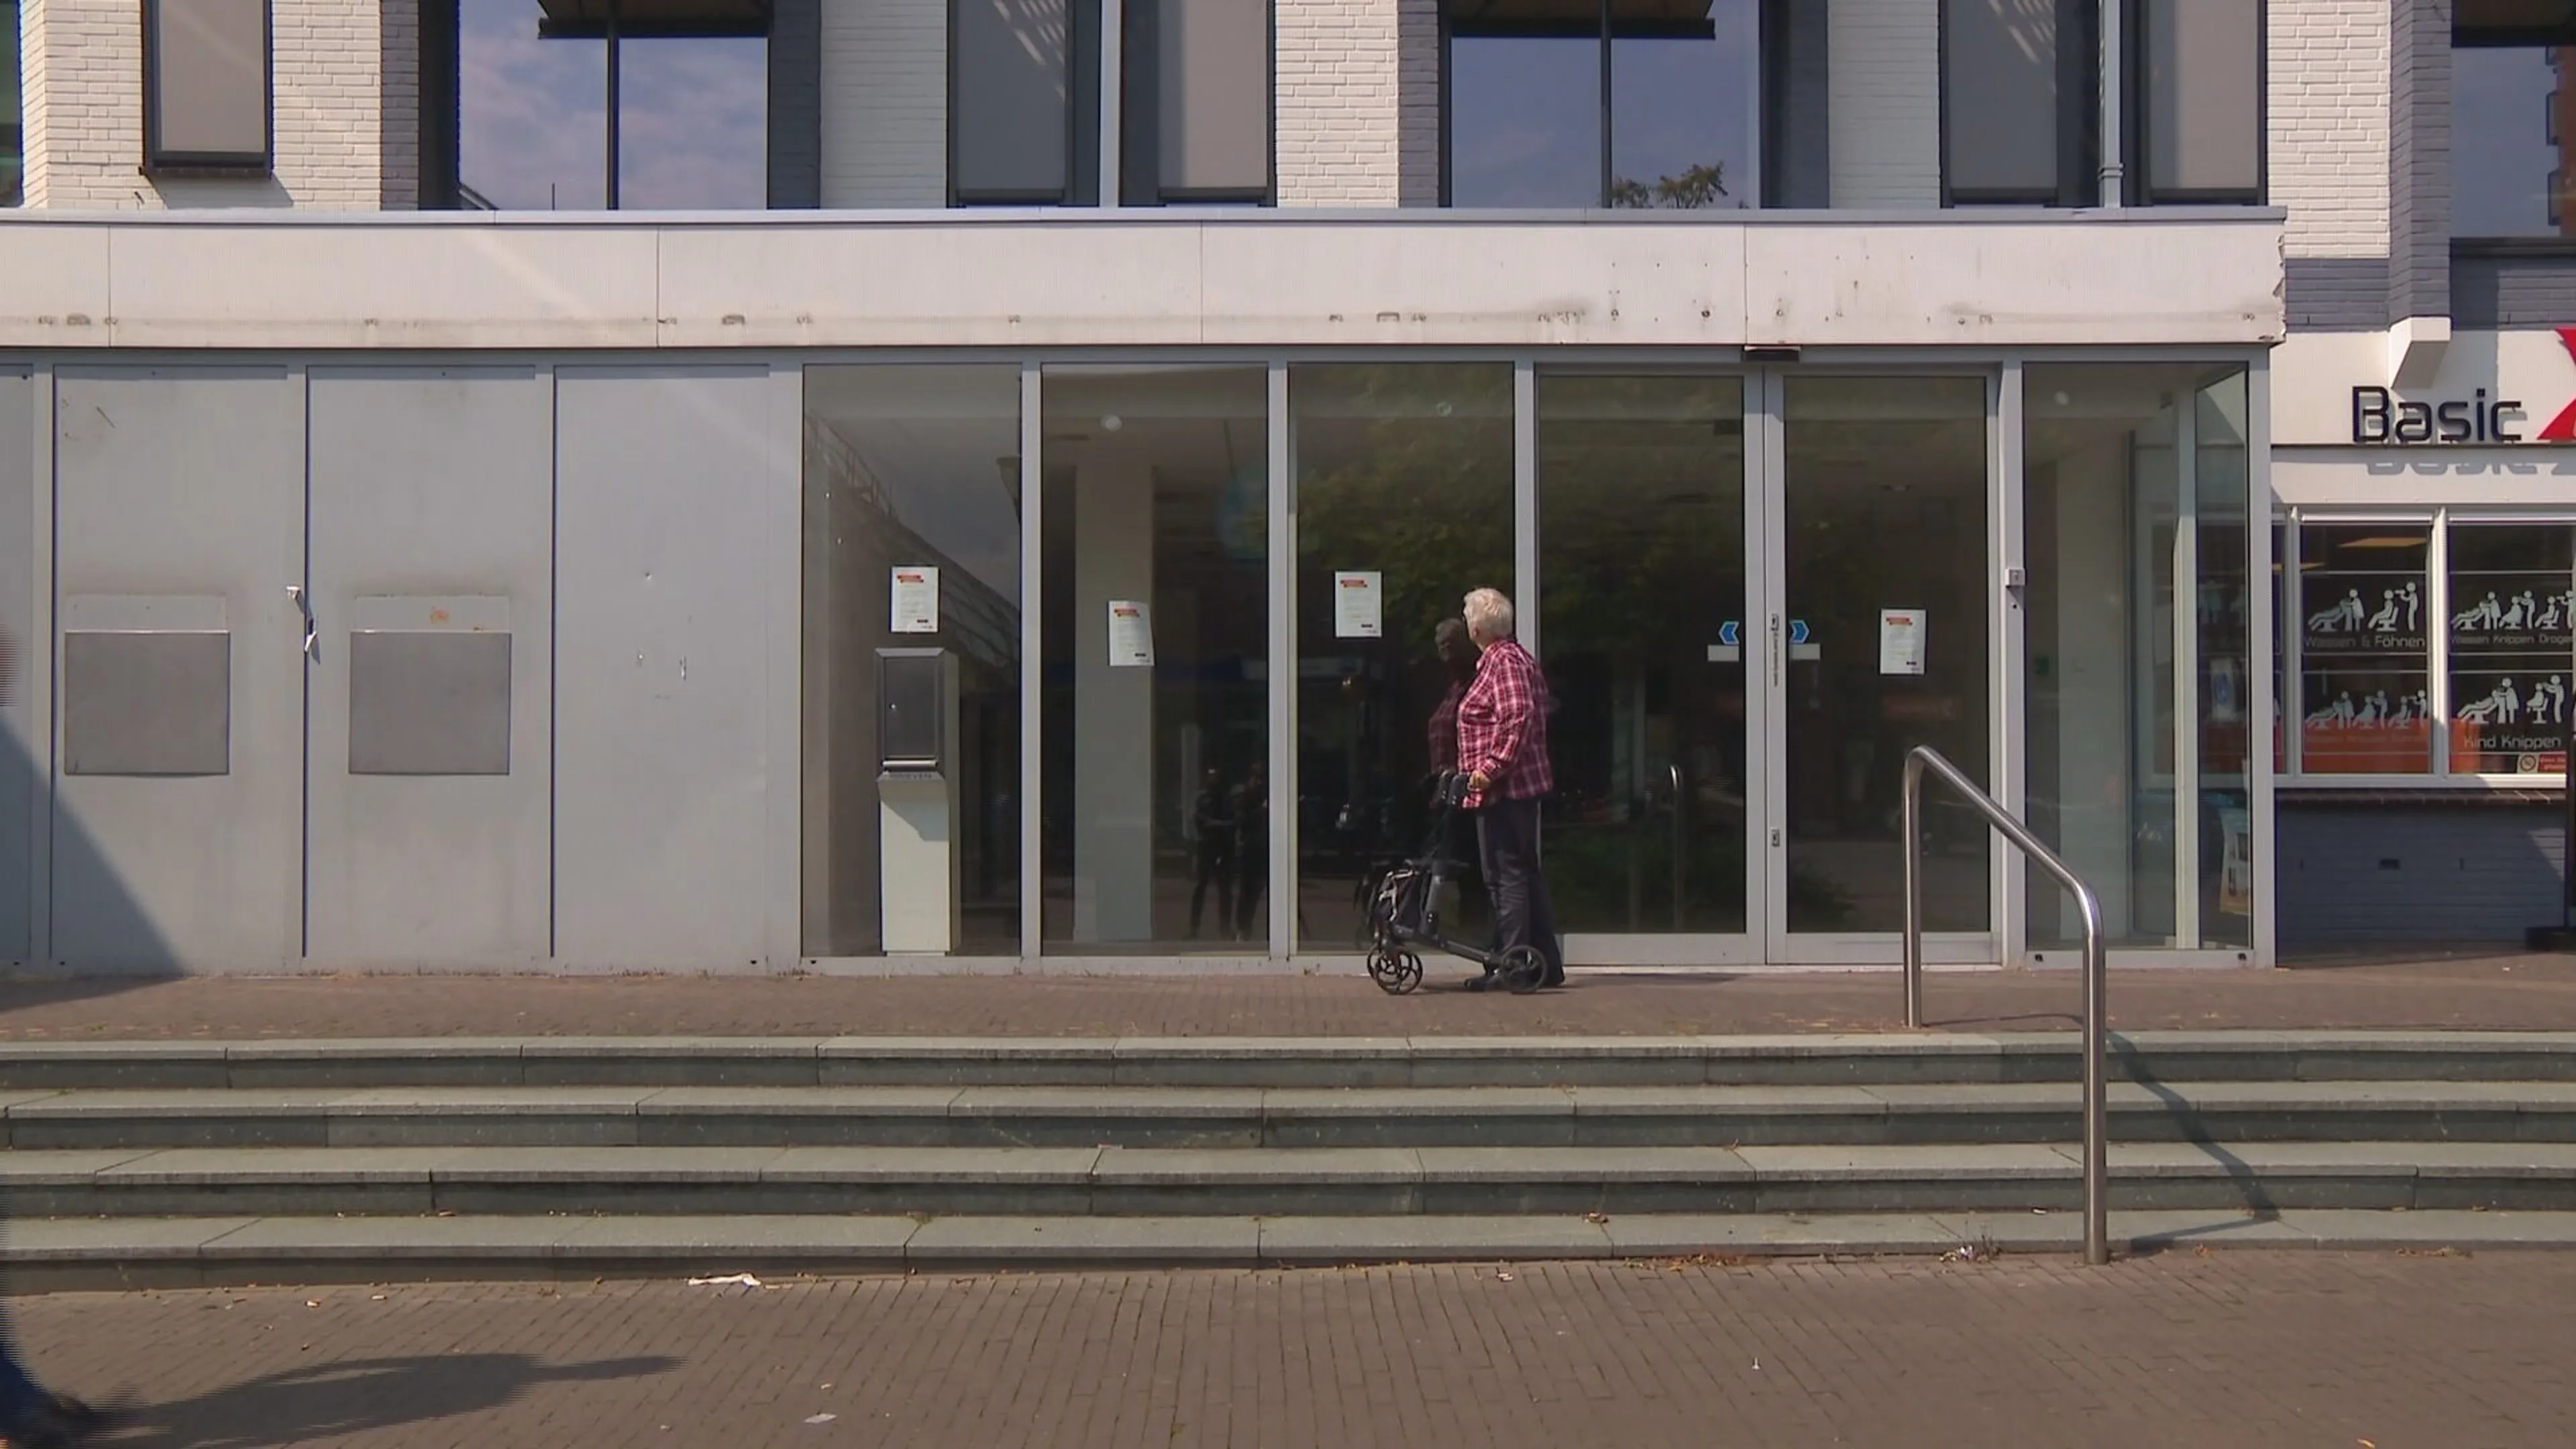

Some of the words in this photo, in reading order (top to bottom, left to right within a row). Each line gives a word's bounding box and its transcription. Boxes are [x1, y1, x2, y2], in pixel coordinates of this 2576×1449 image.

[2352, 386, 2522, 443] Basic
[2464, 735, 2497, 749] Kind
[2501, 735, 2562, 749] Knippen
